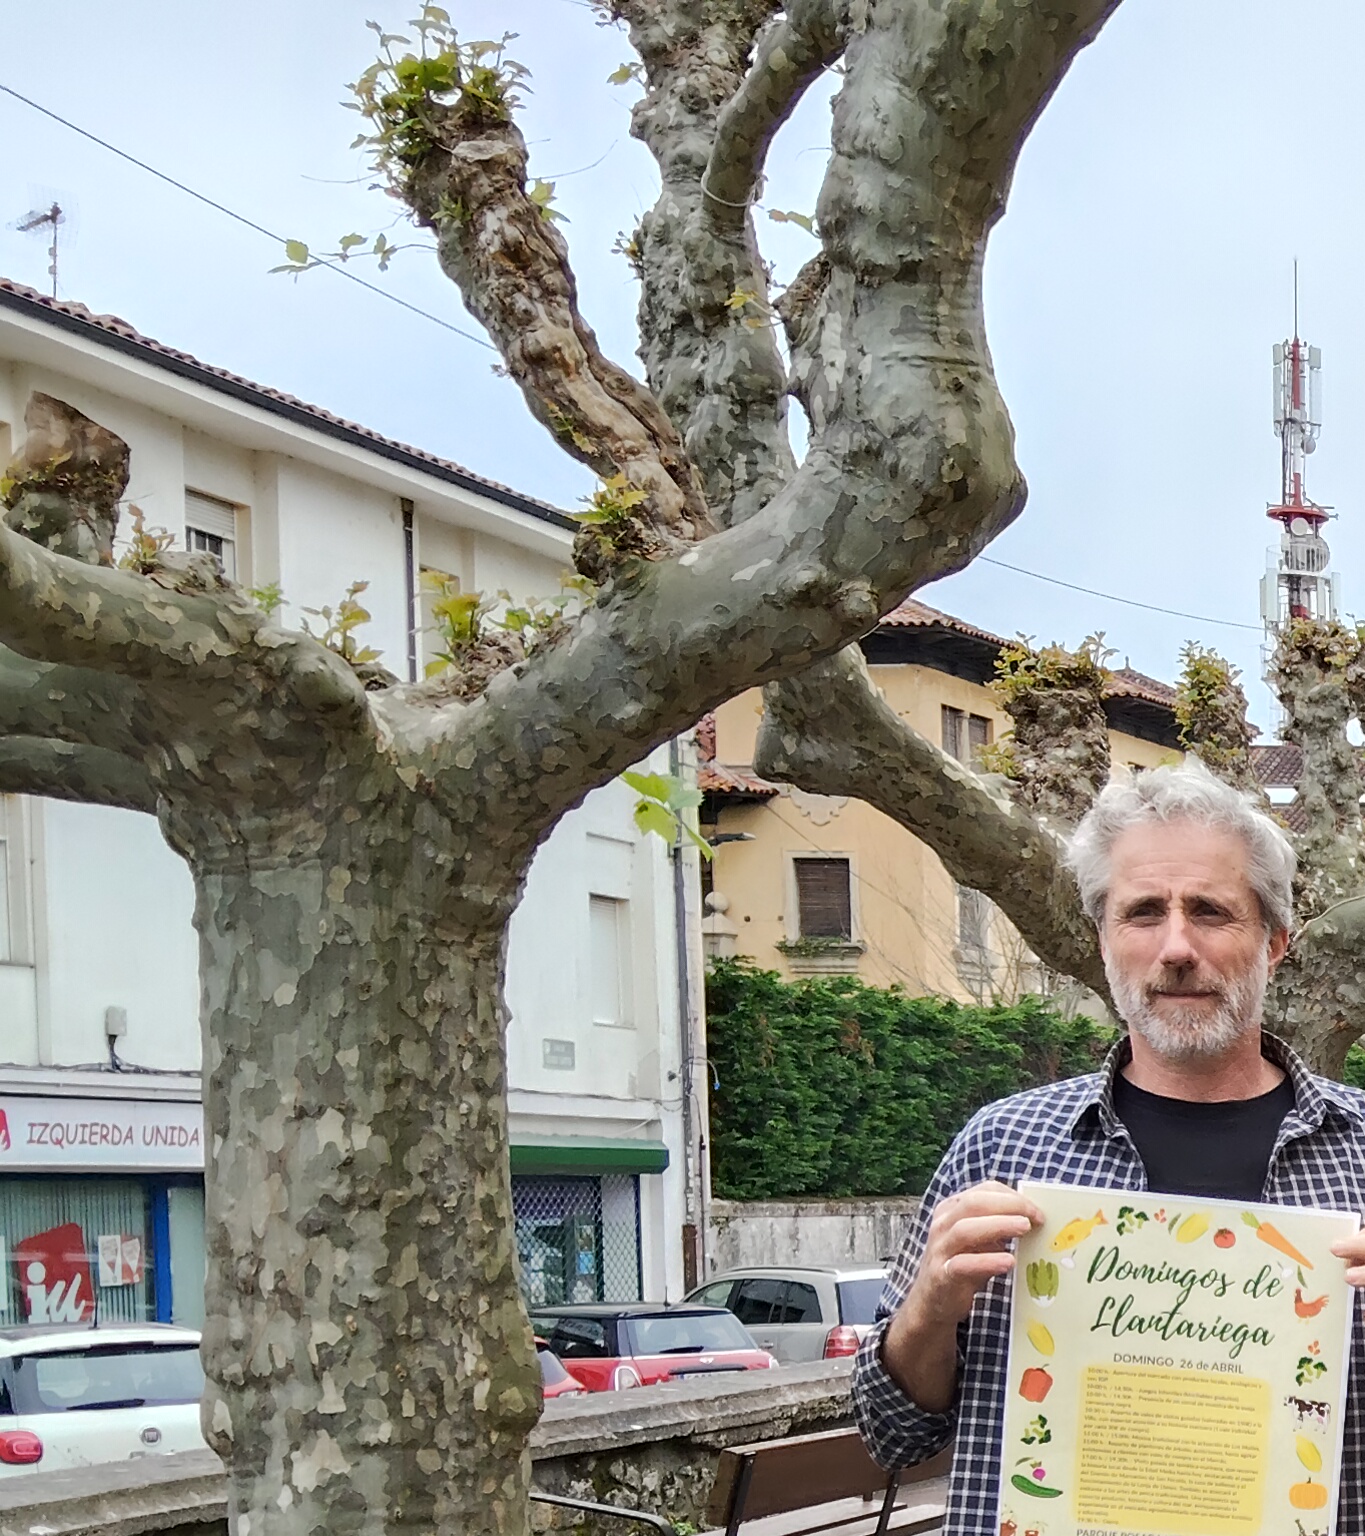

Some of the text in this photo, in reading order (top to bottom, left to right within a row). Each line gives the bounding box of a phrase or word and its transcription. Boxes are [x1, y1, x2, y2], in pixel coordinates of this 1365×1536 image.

[27, 1122, 134, 1149] IZQUIERDA
[143, 1124, 200, 1148] UNIDA
[1085, 1243, 1285, 1309] Domingos de
[1089, 1291, 1276, 1363] Llantariega
[1113, 1352, 1244, 1374] DOMINGO 26 de ABRIL
